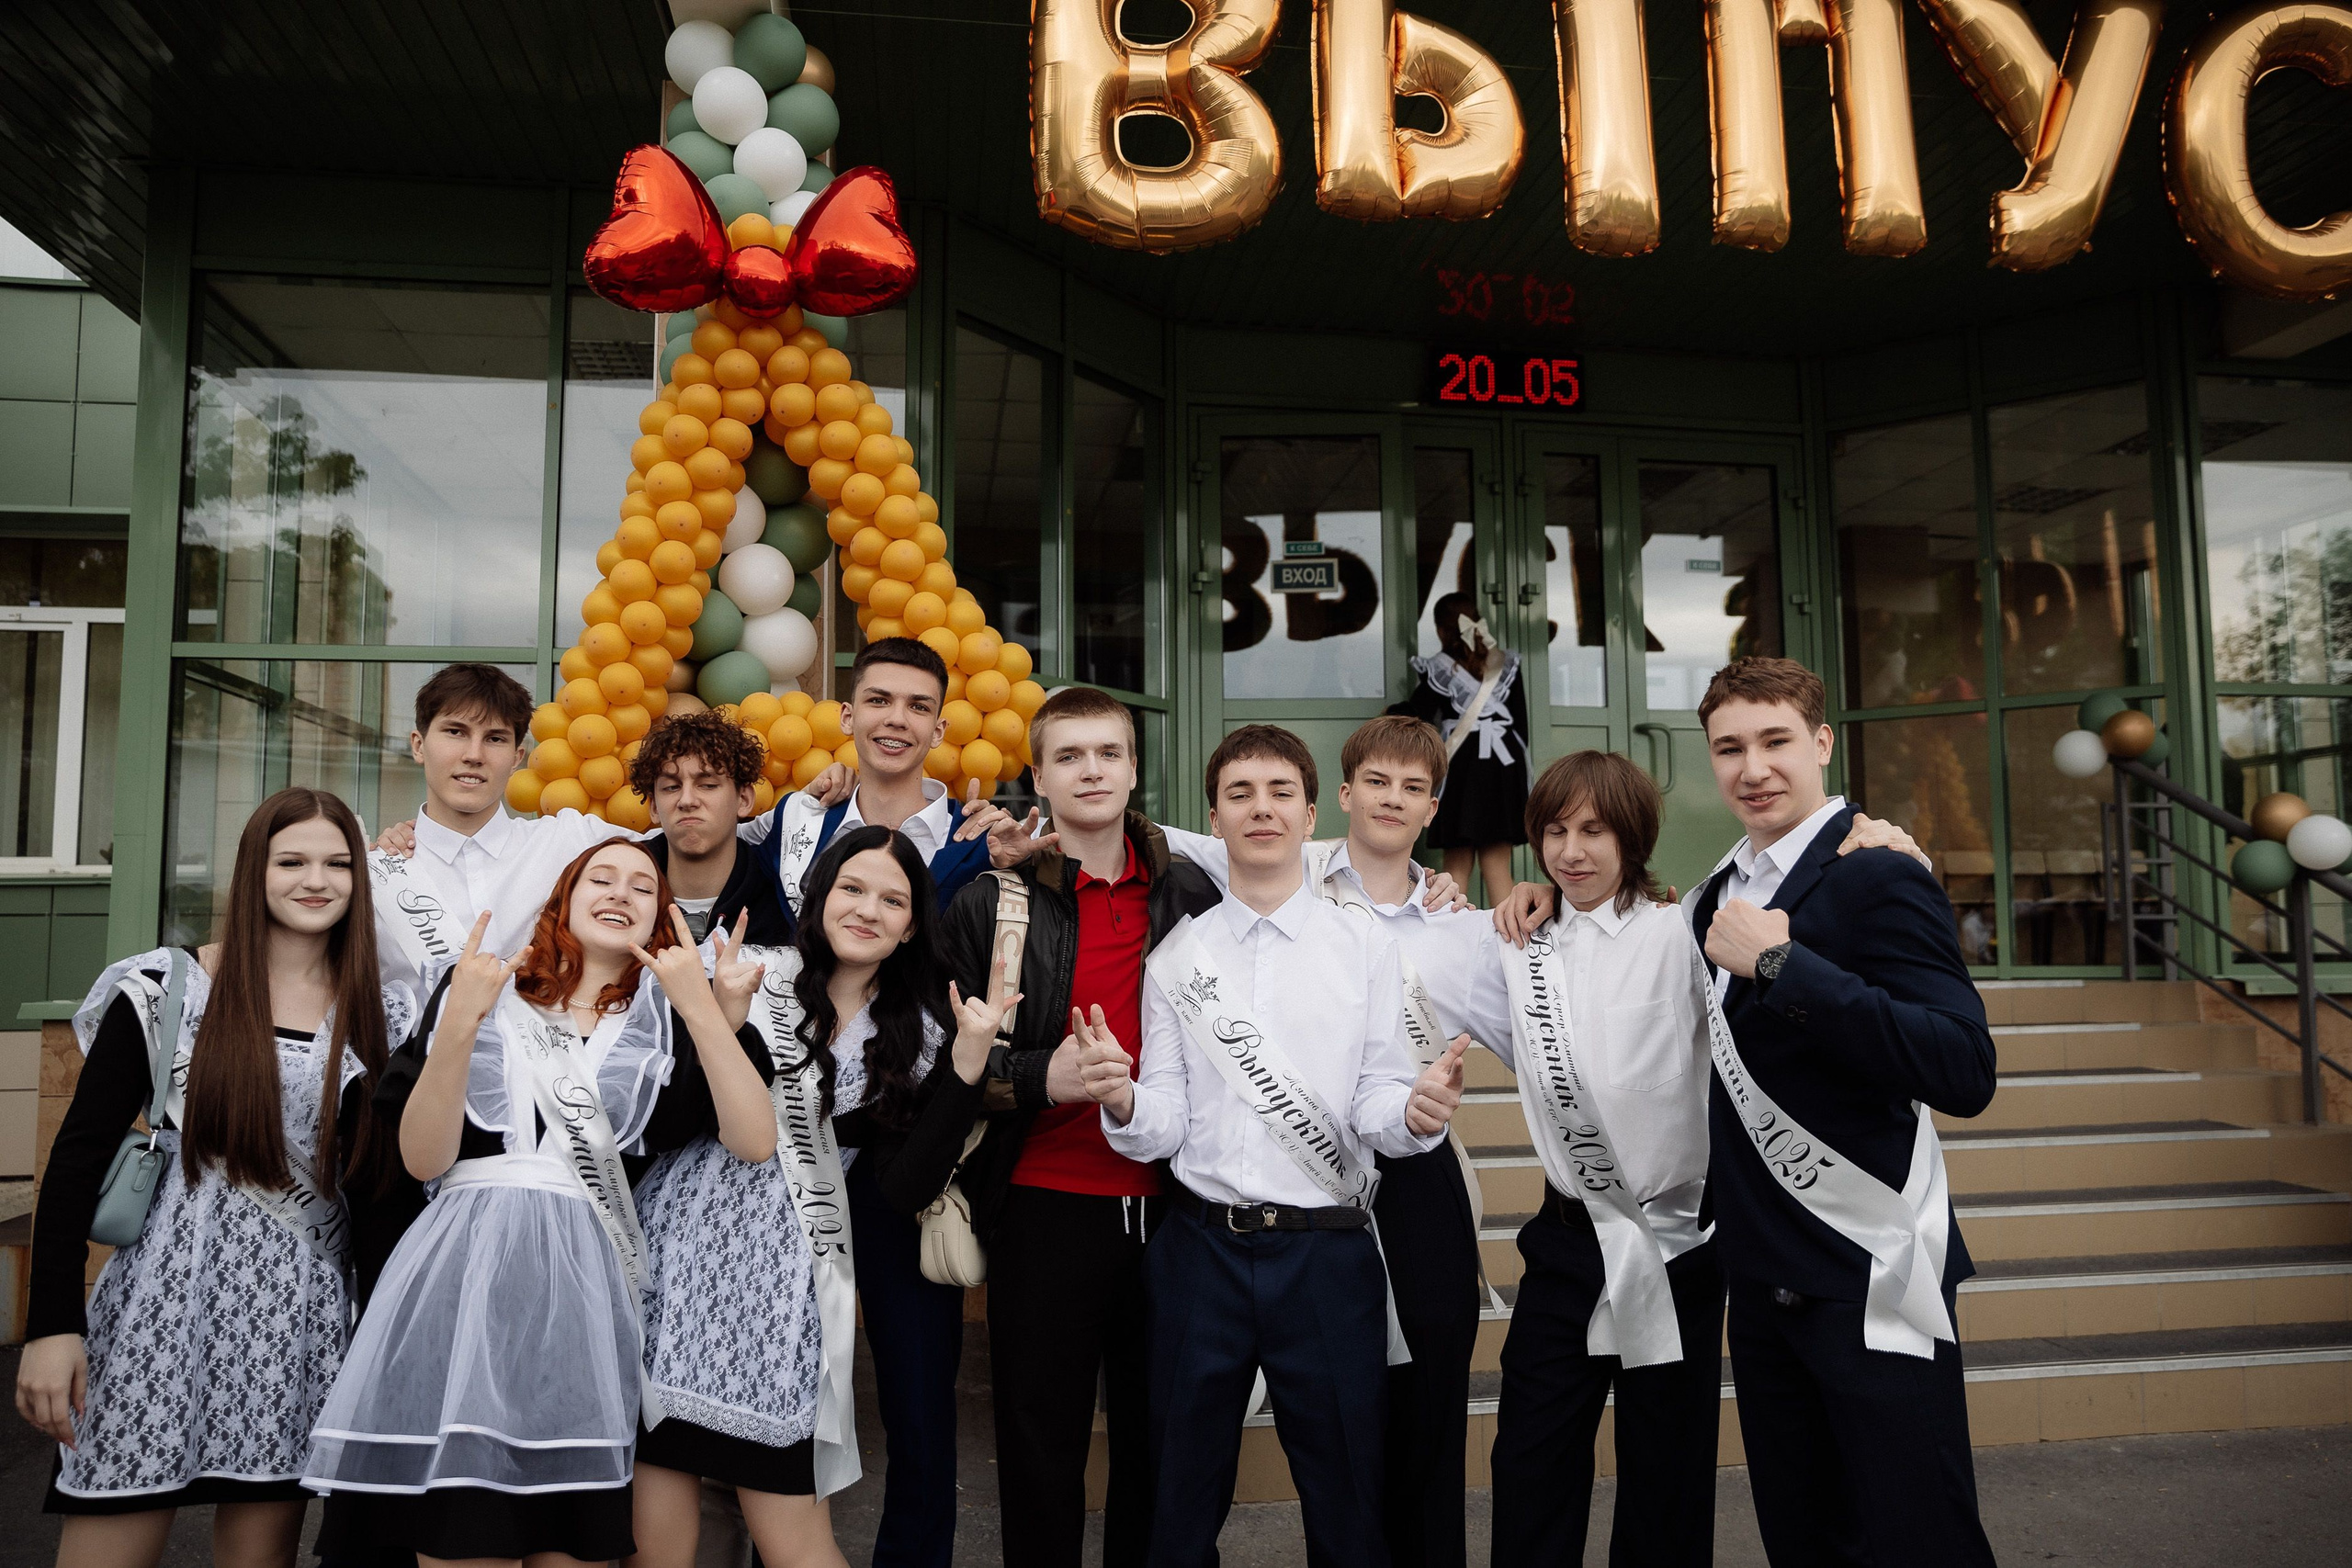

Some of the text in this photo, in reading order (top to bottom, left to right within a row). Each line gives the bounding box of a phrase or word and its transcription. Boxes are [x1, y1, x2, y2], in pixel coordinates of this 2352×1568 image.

[1282, 567, 1328, 586] ВХОД
[1212, 1014, 1347, 1181] Выпускник
[1523, 929, 1625, 1192] Выпускник 2025
[1563, 1032, 1585, 1092] Дмитрий
[1748, 1111, 1836, 1190] 2025
[792, 1180, 849, 1258] 2025
